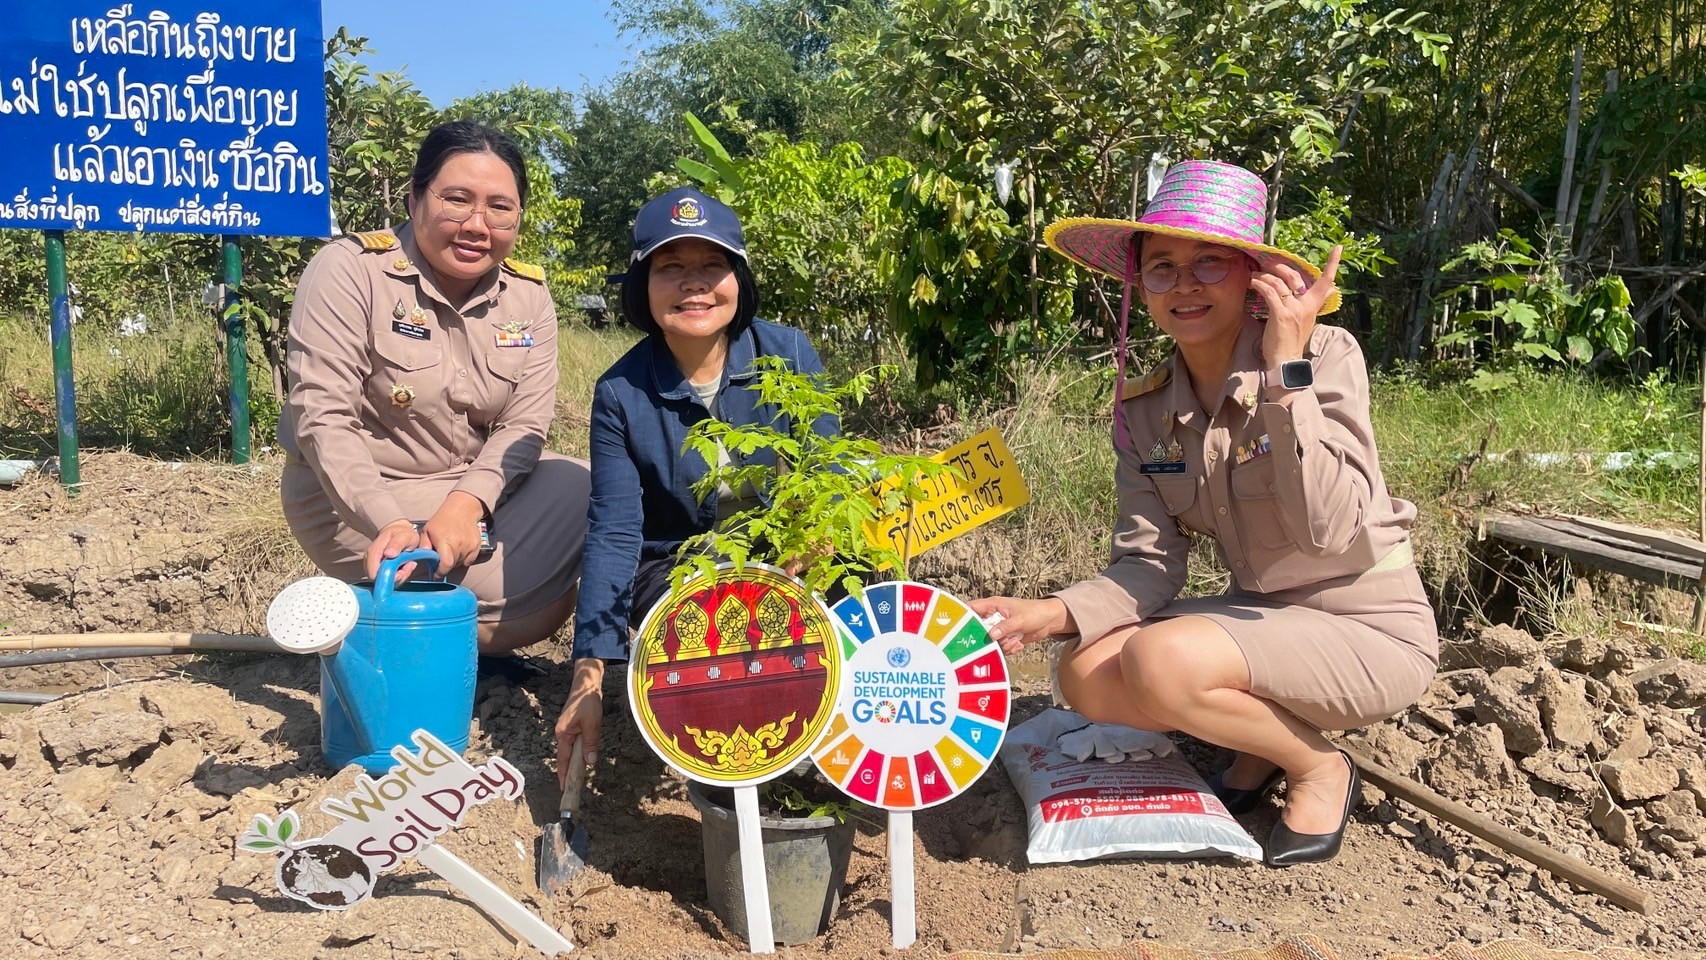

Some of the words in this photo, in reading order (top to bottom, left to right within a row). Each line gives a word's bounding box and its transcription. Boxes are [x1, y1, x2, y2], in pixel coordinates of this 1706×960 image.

[853, 671, 946, 685] SUSTAINABLE
[853, 686, 946, 699] DEVELOPMENT
[852, 699, 947, 726] GOALS
[326, 735, 455, 823] World
[356, 808, 442, 868] Soil
[421, 762, 519, 822] Day
